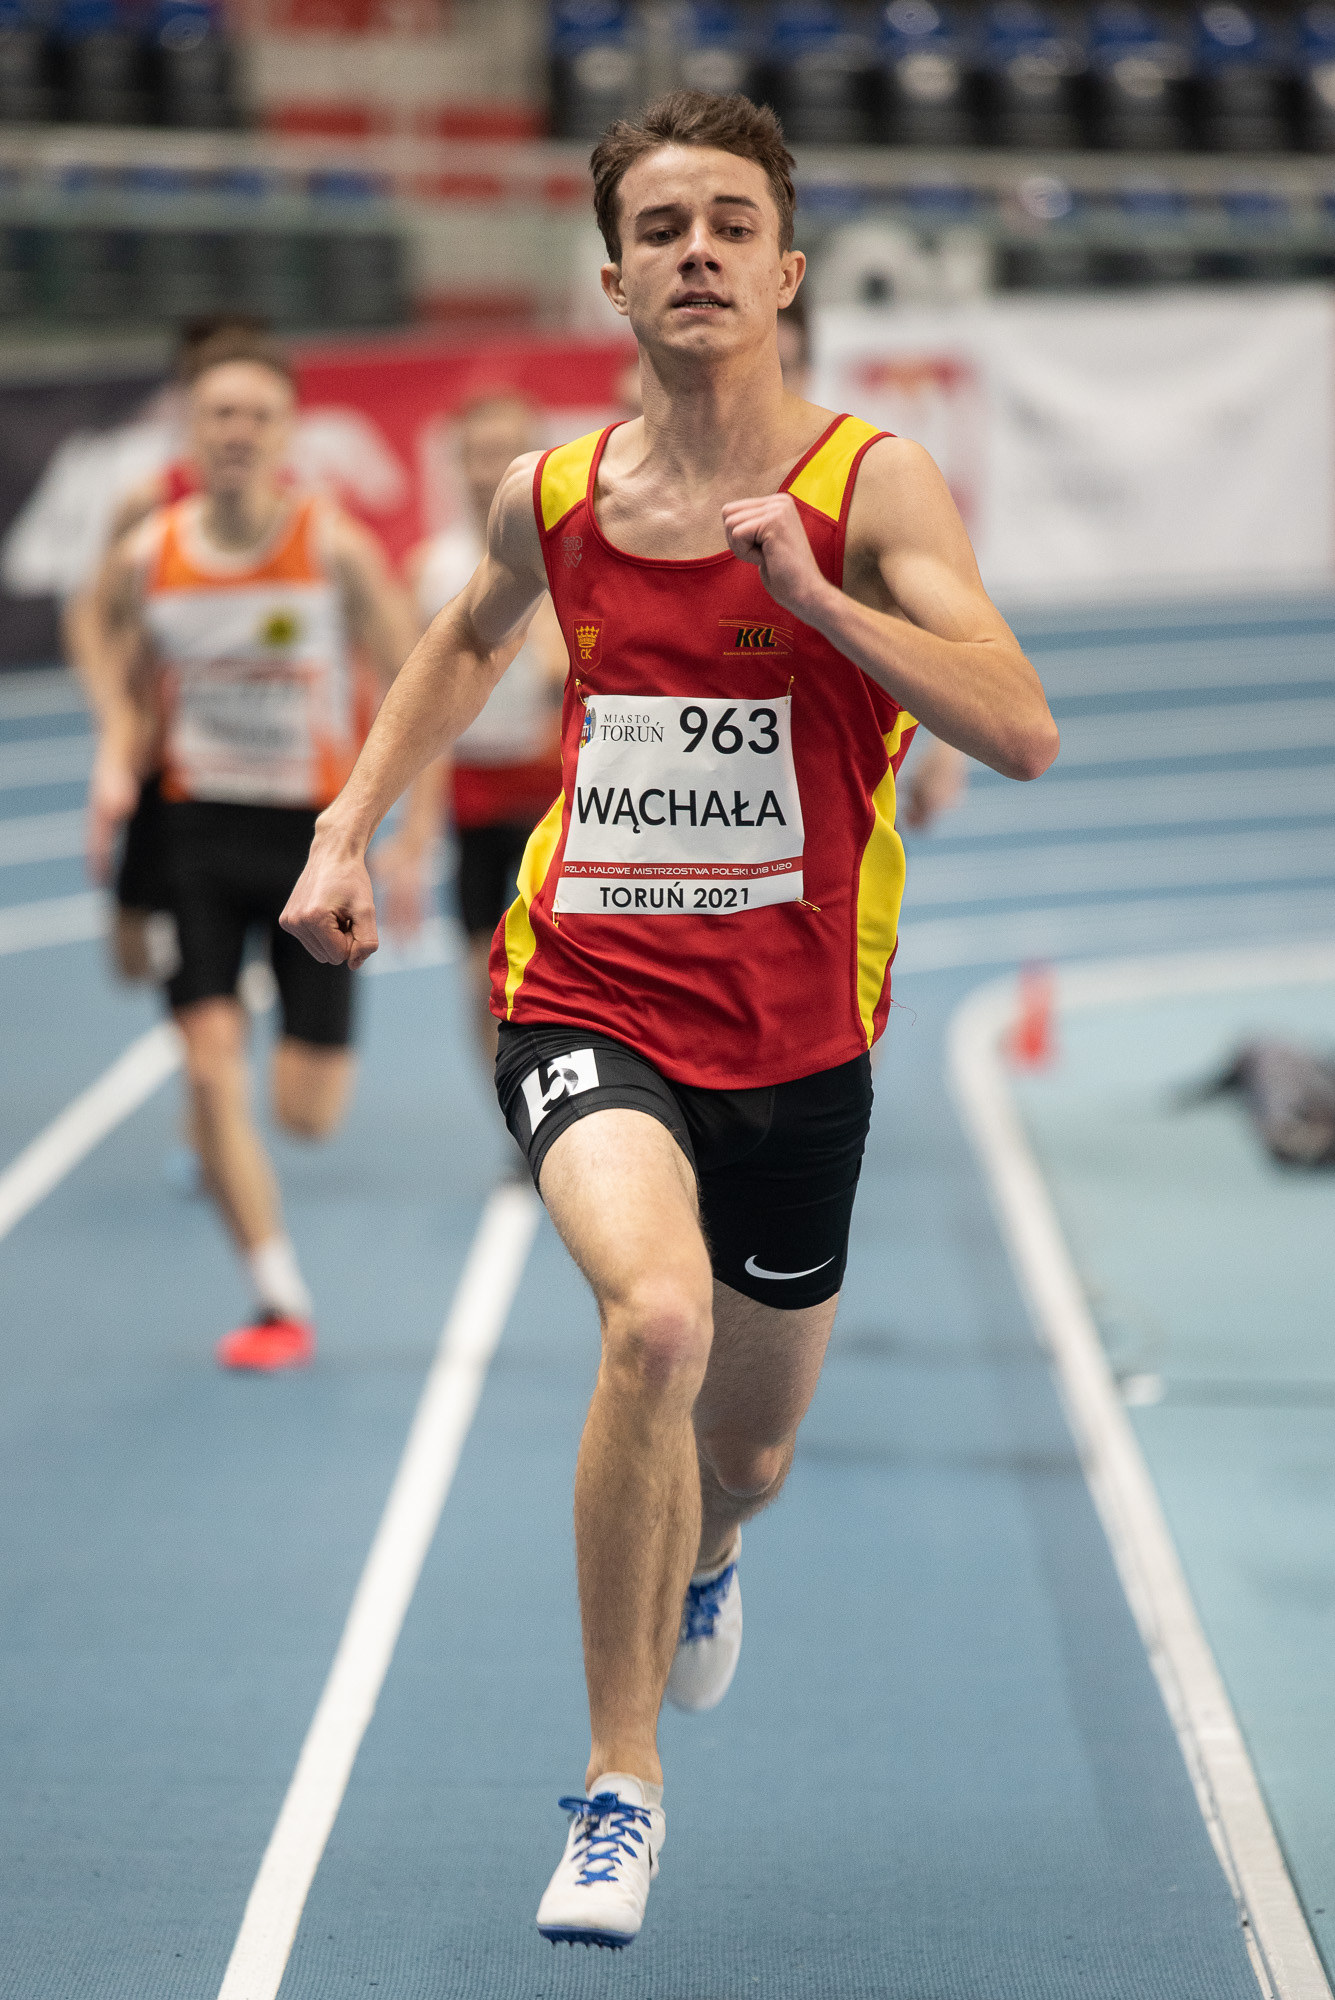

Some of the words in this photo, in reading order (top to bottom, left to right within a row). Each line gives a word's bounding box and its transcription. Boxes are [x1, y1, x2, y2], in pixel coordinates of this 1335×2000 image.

[580, 648, 593, 660] CK
[603, 714, 650, 724] MIASTO
[679, 705, 780, 755] 963
[600, 721, 665, 743] TORUŃ
[577, 786, 787, 834] WĄCHAŁA
[564, 865, 587, 874] PZLA
[588, 866, 631, 875] HALOWE
[632, 867, 710, 876] MISTRZOSTWA
[711, 867, 749, 876] POLSKI
[750, 866, 770, 875] U18
[771, 862, 793, 872] U20
[600, 881, 684, 909] TORUŃ
[693, 887, 750, 909] 2021
